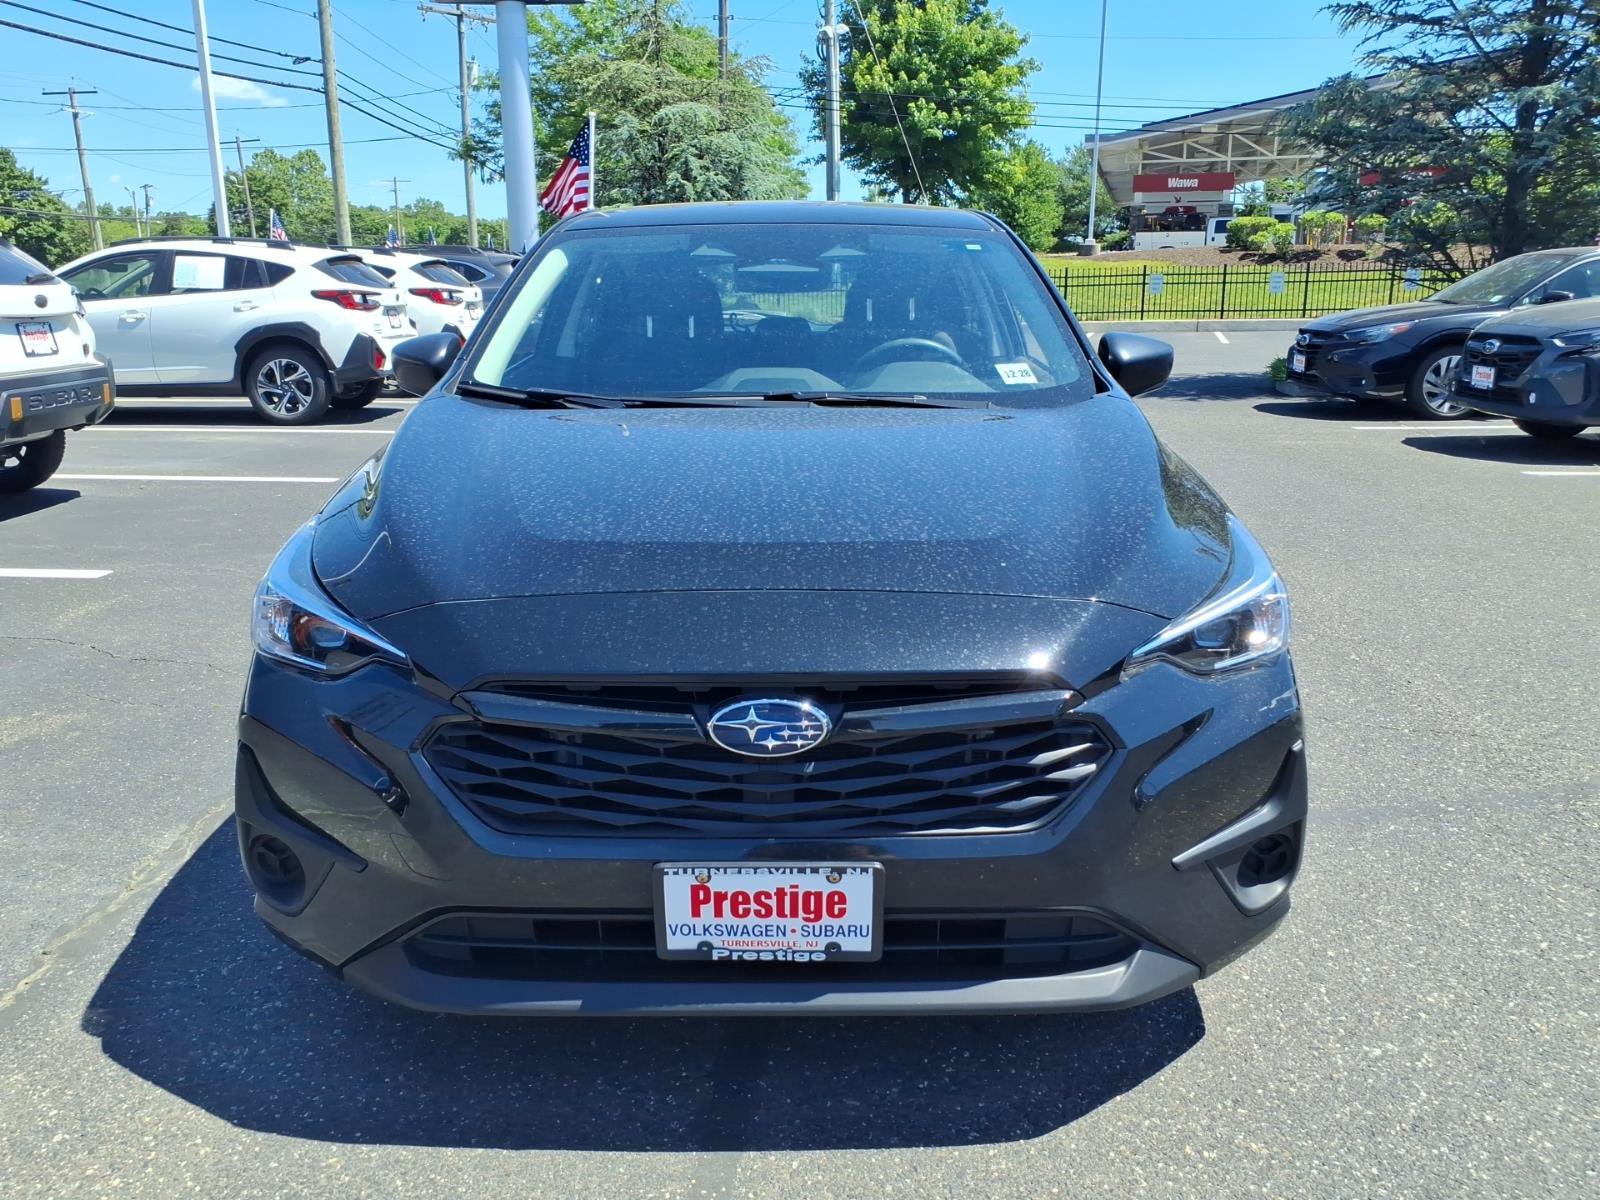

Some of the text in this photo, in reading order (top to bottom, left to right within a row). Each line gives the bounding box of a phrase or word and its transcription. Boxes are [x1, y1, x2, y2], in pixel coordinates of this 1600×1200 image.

[1168, 177, 1198, 188] Wawa
[1018, 369, 1031, 378] 28
[690, 883, 847, 923] Prestige
[669, 924, 870, 938] VOLKSWAGEN SUBARU
[720, 939, 819, 948] TURNERSVILLE, NJ
[712, 948, 826, 962] Prestige
